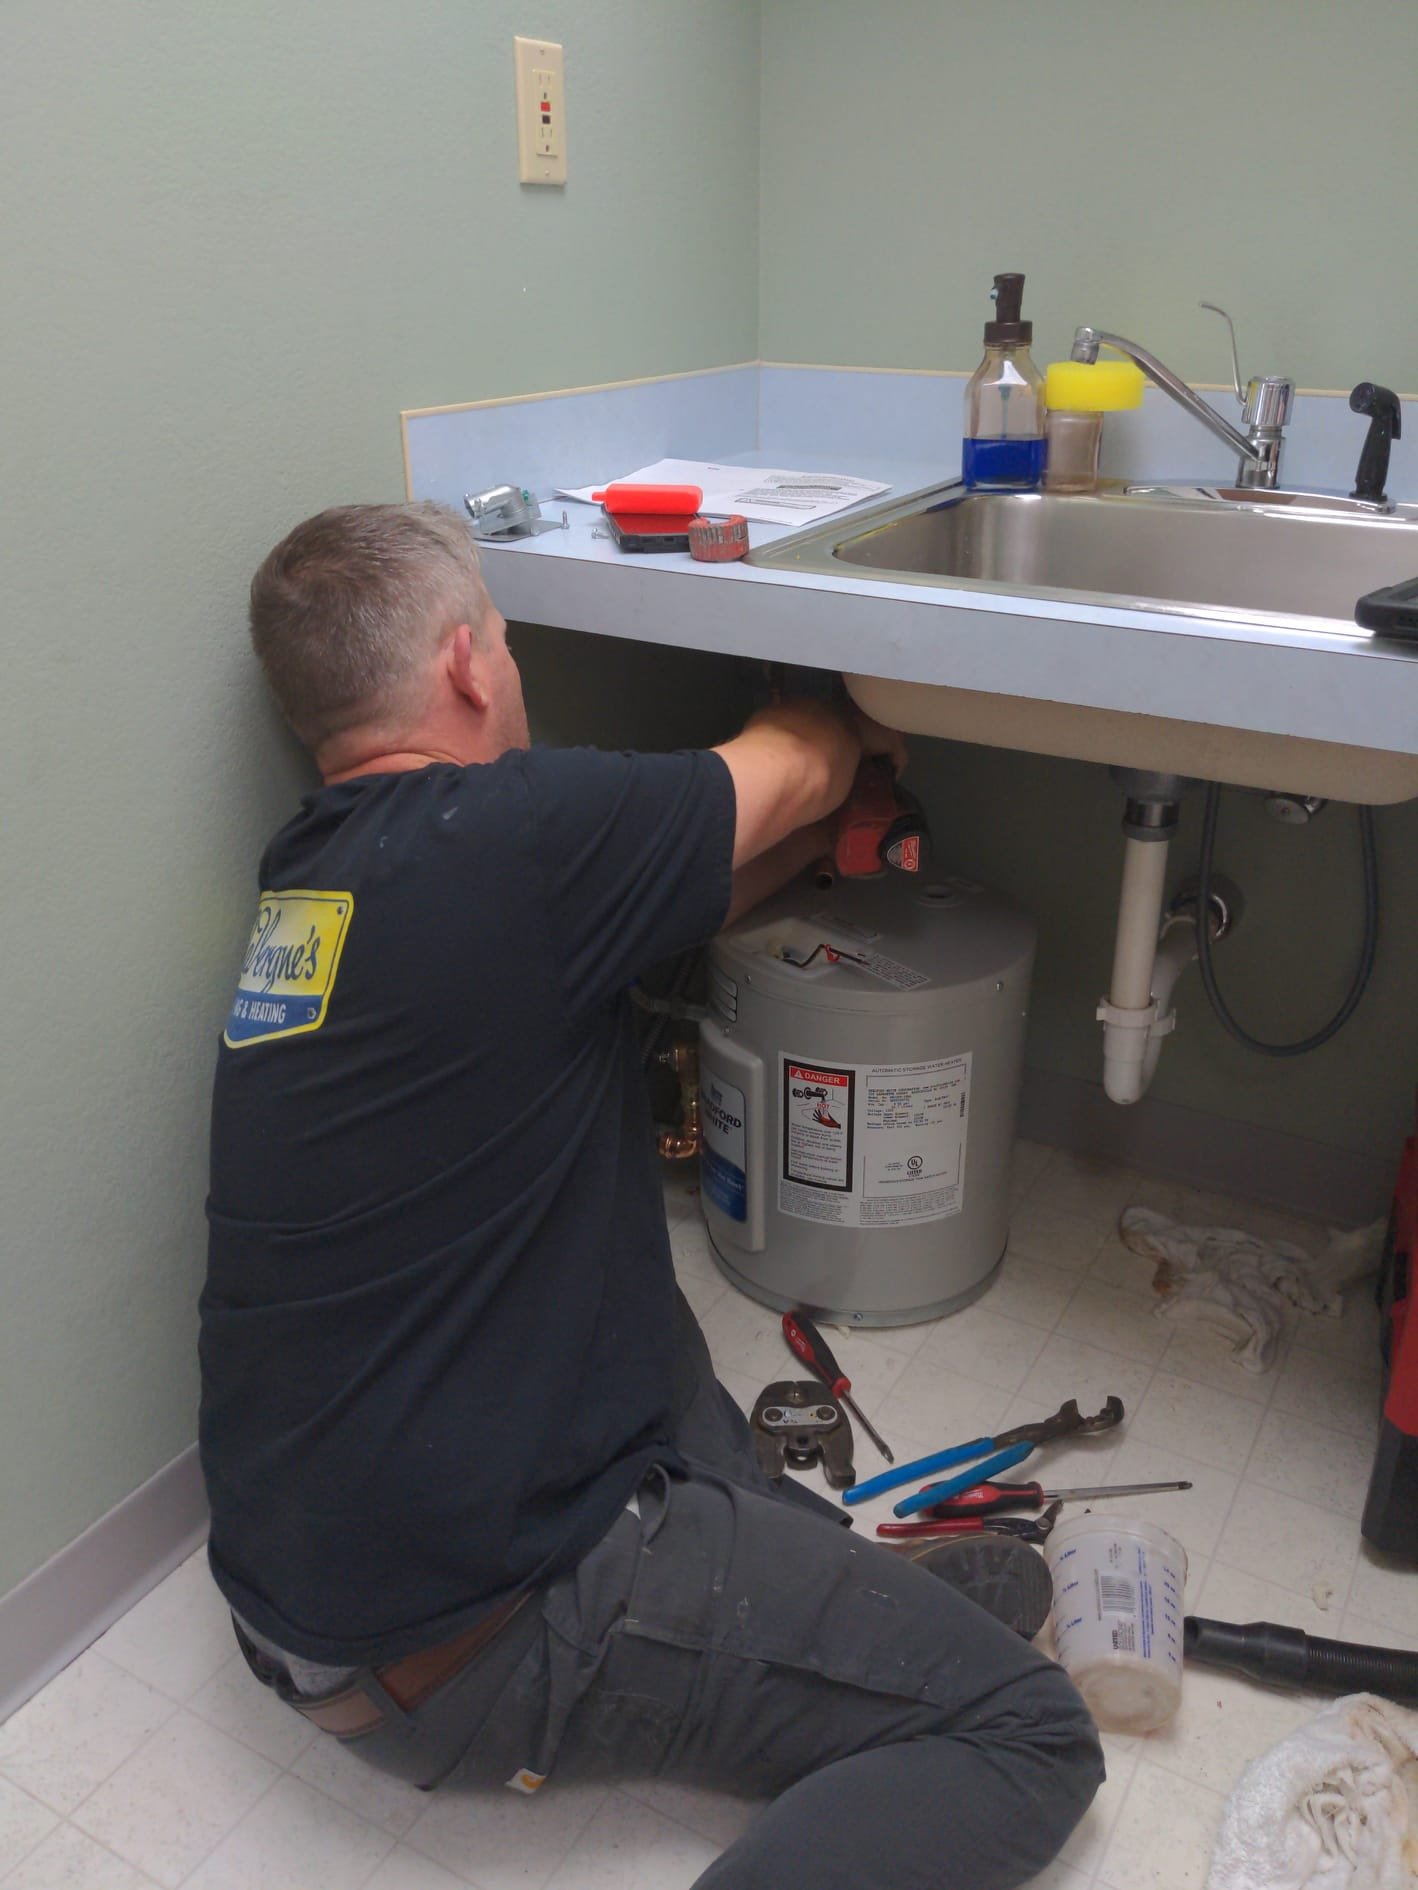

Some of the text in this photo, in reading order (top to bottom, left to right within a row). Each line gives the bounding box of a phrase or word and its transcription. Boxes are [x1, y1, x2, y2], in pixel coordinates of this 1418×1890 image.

[242, 906, 321, 993] Vergne's
[249, 1001, 287, 1023] HEATING
[804, 1072, 840, 1084] DANGER
[816, 1102, 831, 1110] HOT
